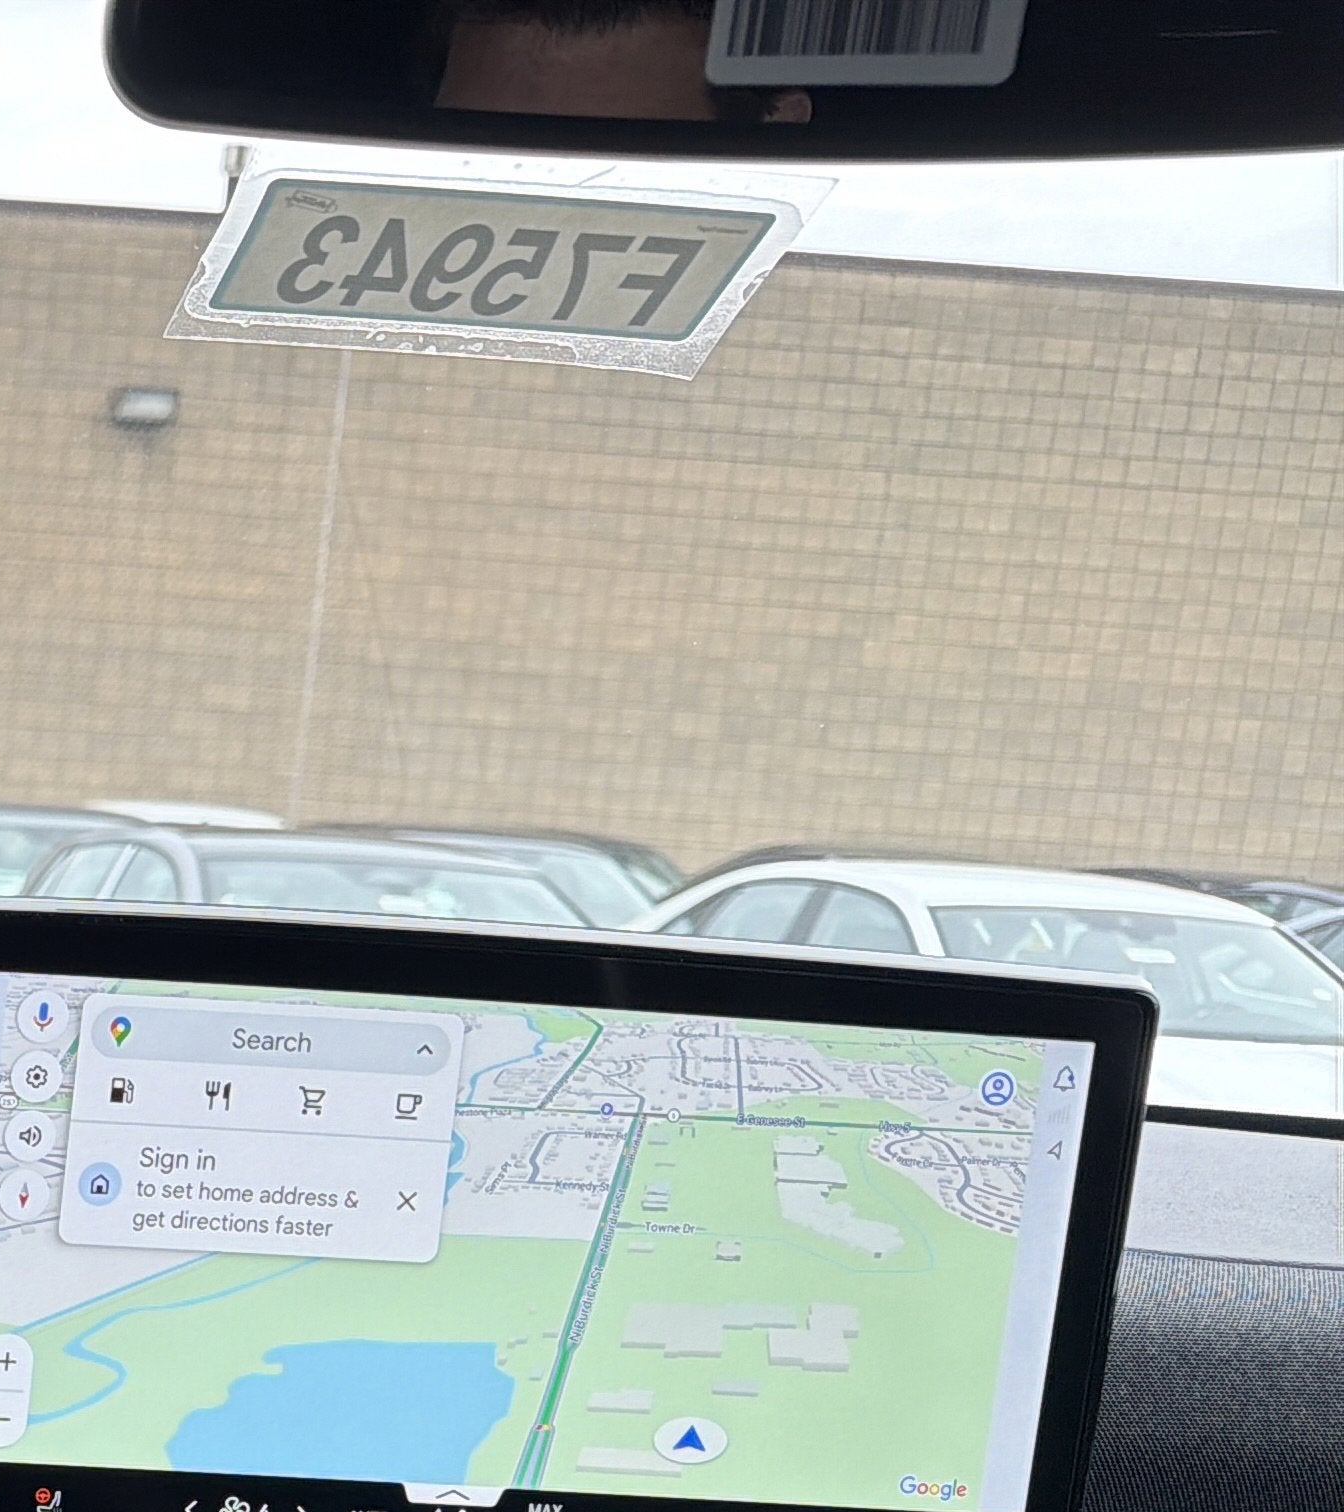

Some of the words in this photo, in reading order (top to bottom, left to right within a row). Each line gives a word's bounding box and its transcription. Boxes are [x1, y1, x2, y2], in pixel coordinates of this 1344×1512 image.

[231, 1027, 313, 1054] Search
[746, 1115, 792, 1127] Genesee
[793, 1116, 806, 1127] St
[140, 1147, 189, 1174] Sign
[197, 1149, 216, 1171] in
[137, 1181, 154, 1199] to
[161, 1181, 194, 1201] set
[199, 1181, 254, 1203] home
[259, 1185, 338, 1208] address
[344, 1190, 359, 1209] &
[555, 1180, 597, 1192] Kennedy
[132, 1212, 166, 1234] get
[171, 1209, 269, 1233] directions
[274, 1214, 333, 1237] faster
[603, 1206, 621, 1242] Burdick
[645, 1221, 680, 1233] Towne
[683, 1222, 696, 1233] Dr
[574, 1284, 598, 1328] Burdick
[591, 1266, 603, 1284] St
[899, 1475, 967, 1501] Google
